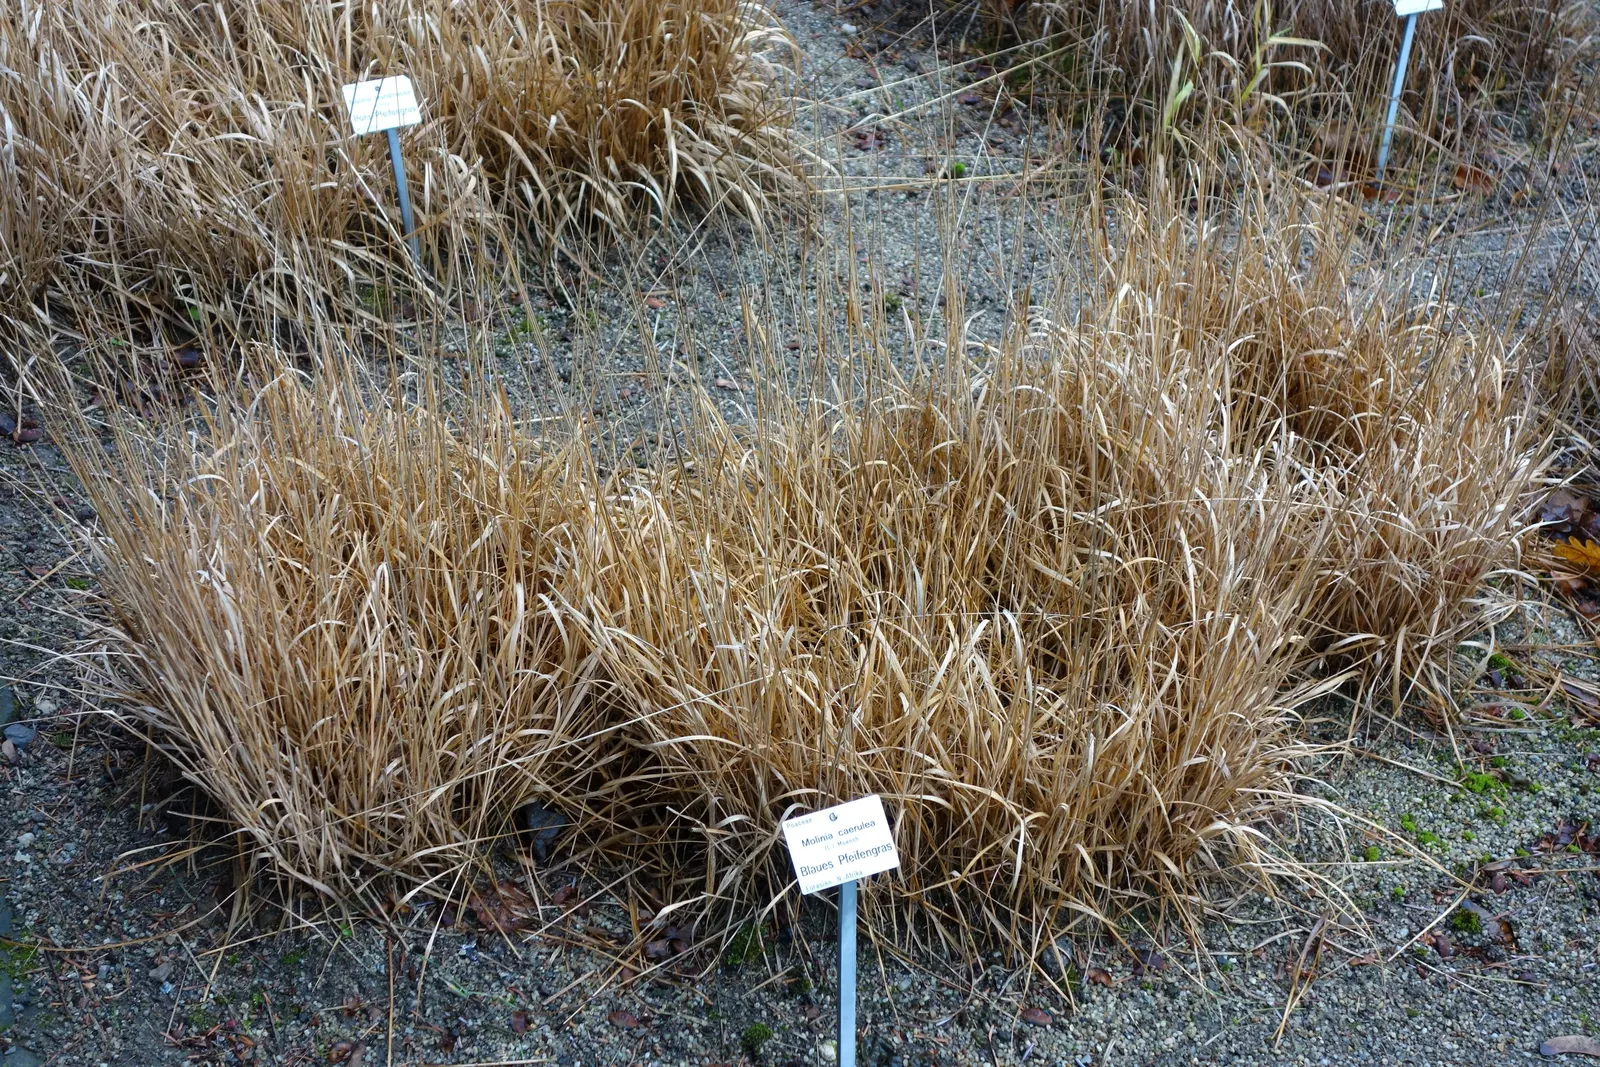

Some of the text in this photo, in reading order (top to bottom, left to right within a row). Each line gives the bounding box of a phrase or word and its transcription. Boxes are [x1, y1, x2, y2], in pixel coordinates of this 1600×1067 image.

[801, 820, 876, 848] Molinia caerulea
[800, 842, 893, 877] Blaues Pfeifengras
